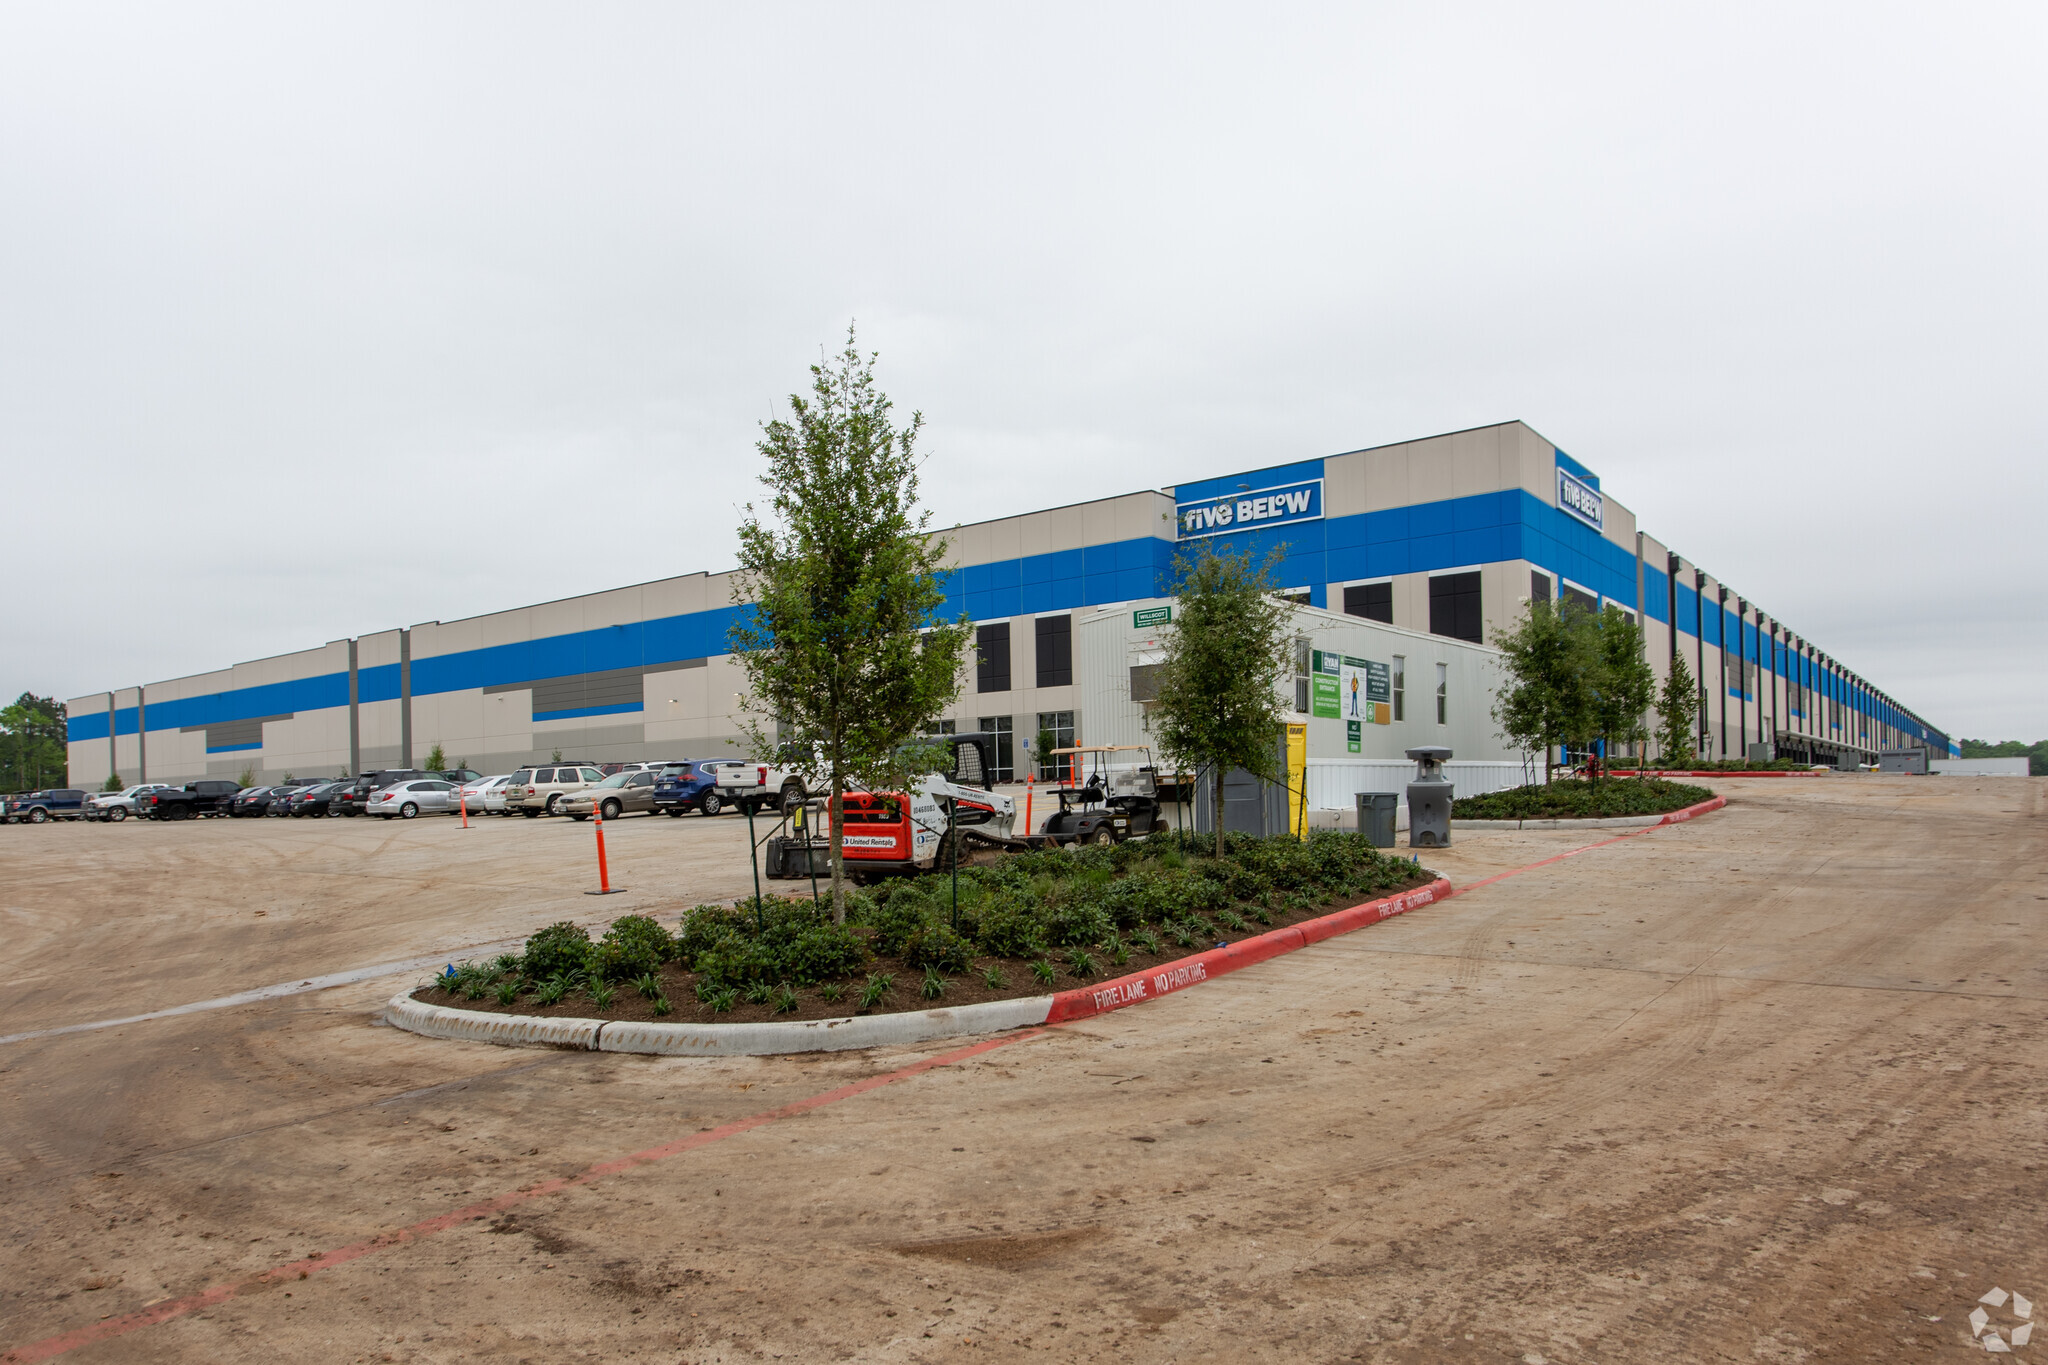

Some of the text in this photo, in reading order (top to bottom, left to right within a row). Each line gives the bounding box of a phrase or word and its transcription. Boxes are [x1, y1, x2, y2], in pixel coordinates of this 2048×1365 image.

[1140, 611, 1165, 620] WILLSCOT
[1324, 656, 1338, 668] RYAN
[850, 838, 893, 847] United Rentals
[1093, 962, 1207, 1009] FIRE LANE NO PARKING
